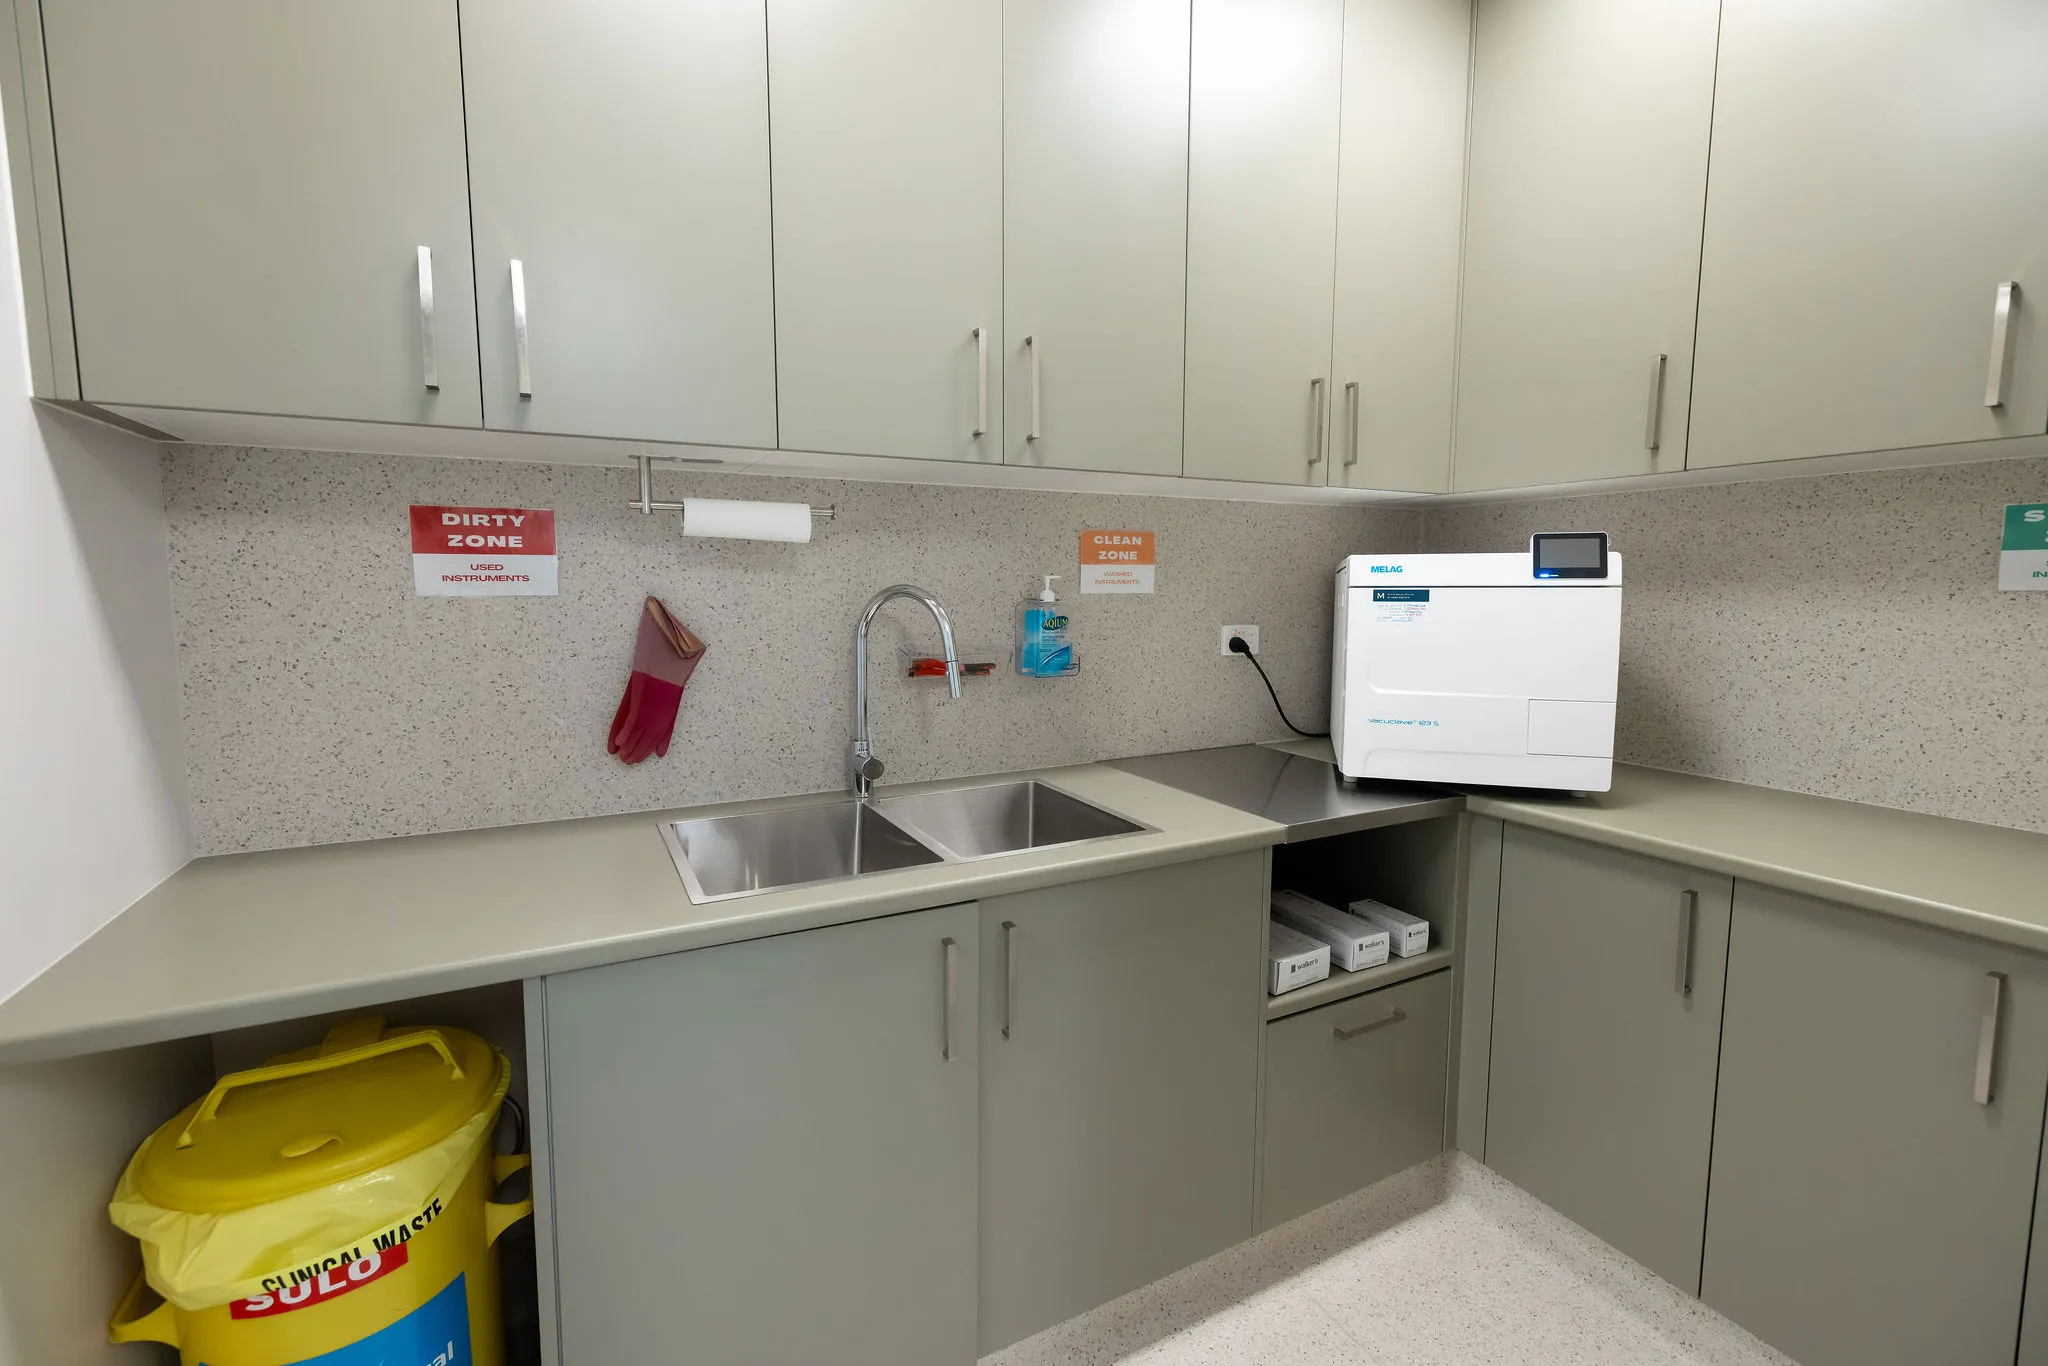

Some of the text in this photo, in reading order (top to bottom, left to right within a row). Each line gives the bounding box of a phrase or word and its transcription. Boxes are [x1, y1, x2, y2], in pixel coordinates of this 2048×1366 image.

[441, 513, 525, 527] DIRTY
[447, 534, 523, 548] ZONE
[1093, 535, 1142, 545] CLEAN
[1098, 550, 1138, 560] ZONE
[470, 563, 504, 571] USED
[1370, 565, 1403, 573] MELAG
[441, 574, 530, 582] INSTRUMENTS
[372, 1198, 443, 1254] WASTE
[245, 1251, 383, 1312] SULO
